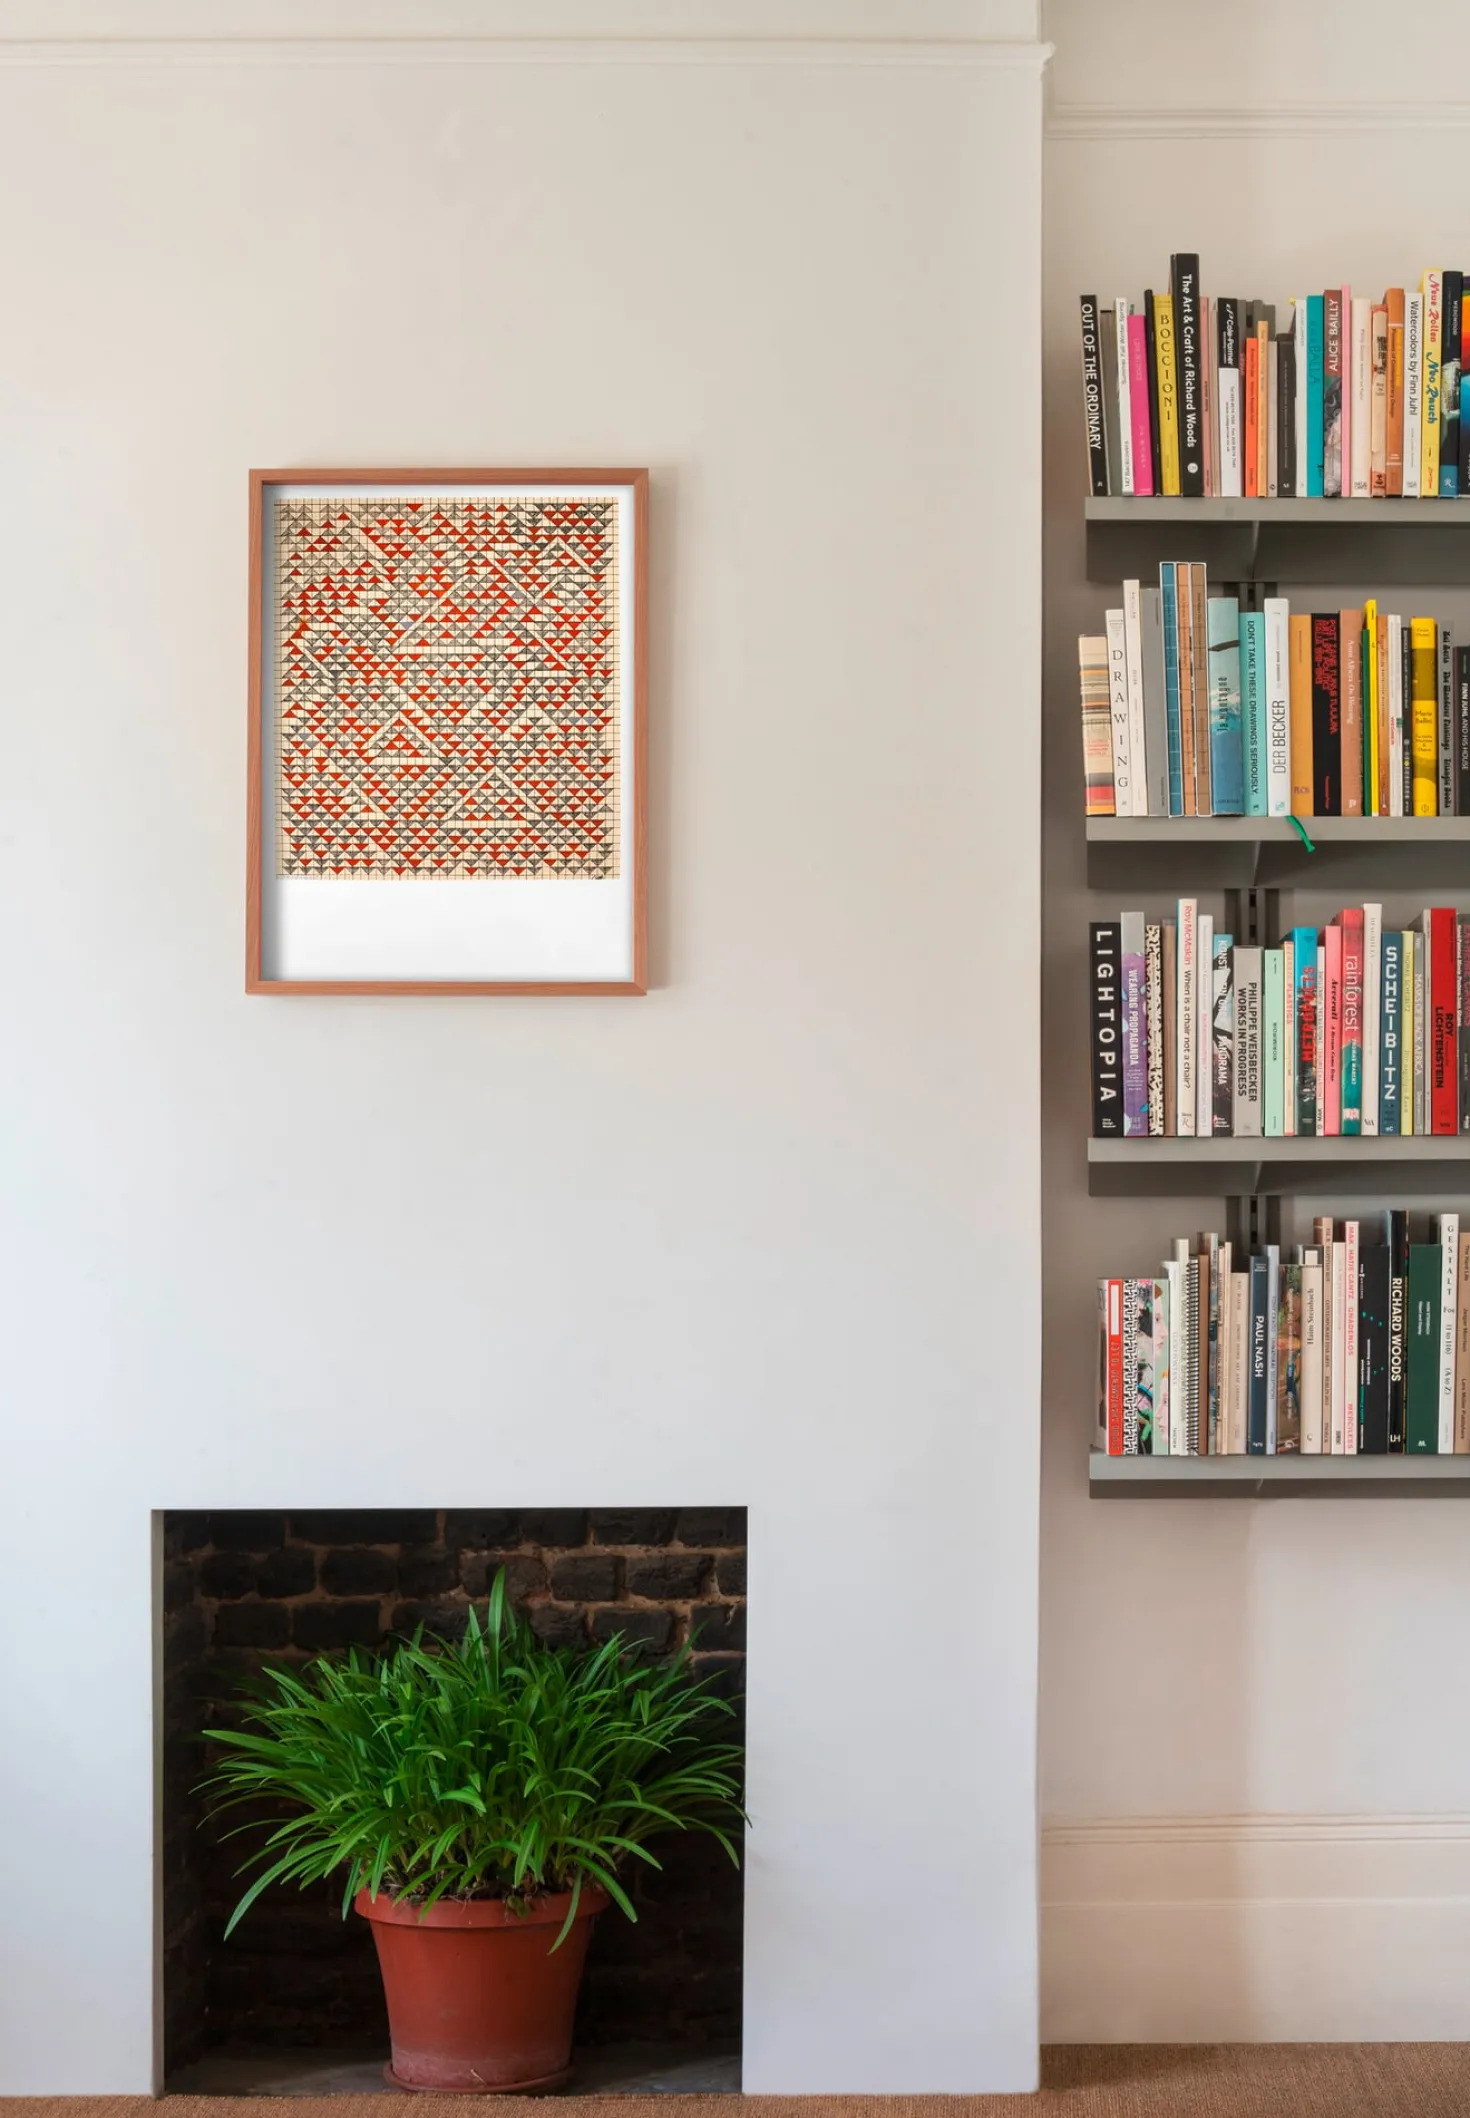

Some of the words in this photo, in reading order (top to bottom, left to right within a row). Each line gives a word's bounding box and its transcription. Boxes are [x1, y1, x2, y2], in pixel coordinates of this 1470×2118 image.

[1182, 274, 1193, 294] The
[1082, 303, 1094, 331] OUT
[1183, 296, 1193, 313] Art
[1328, 299, 1339, 336] BAILLY
[1183, 315, 1193, 324] &
[1409, 300, 1420, 359] Watercolors
[1083, 334, 1095, 353] OF
[1183, 326, 1195, 354] Craft
[1084, 356, 1097, 380] THE
[1160, 314, 1174, 421] BOCCIONI
[1184, 356, 1195, 368] of
[1328, 340, 1339, 372] ALICE
[1408, 360, 1417, 372] by
[1185, 370, 1197, 410] Richard
[1409, 374, 1418, 395] Finn
[1086, 384, 1102, 450] ORDINARY
[1409, 397, 1418, 416] Juhl
[1426, 384, 1440, 425] Rauch
[1186, 412, 1198, 448] Woods
[1247, 620, 1256, 645] DON'T
[1247, 647, 1256, 670] TAKE
[1345, 659, 1355, 683] Albers
[1248, 671, 1257, 699] THESE
[1461, 682, 1469, 700] FINN
[1111, 649, 1129, 788] DRAWING
[1249, 700, 1258, 746] DRAWINGS
[1461, 700, 1469, 718] JUHL
[1272, 700, 1287, 747] BECKER
[1461, 718, 1469, 734] AND
[1461, 734, 1469, 746] HIS
[1272, 750, 1287, 774] DER
[1461, 747, 1469, 771] HOUSE
[1182, 905, 1193, 923] Roy
[1183, 924, 1193, 966] McMakin
[1128, 969, 1139, 1009] WEARING
[1183, 970, 1193, 996] When
[1343, 955, 1362, 1032] rainforest
[1183, 996, 1193, 1005] is
[1237, 987, 1247, 1026] WORKS
[1248, 981, 1258, 1031] PHILIPPE
[1096, 930, 1117, 1102] LIGHTOPIA
[1183, 1013, 1192, 1036] chair
[1383, 946, 1398, 1101] SCHEIBITZ
[1445, 1012, 1454, 1037] ROY
[1128, 1011, 1140, 1066] PROPAGANDA
[1183, 1037, 1192, 1053] not
[1237, 1028, 1247, 1040] IN
[1434, 1005, 1444, 1089] LICHTENSTEIN
[1183, 1061, 1193, 1089] chair?
[1237, 1041, 1247, 1097] PROGRESS
[1248, 1033, 1258, 1102] WEISBECKER
[1446, 1224, 1455, 1296] GESTALT
[1347, 1272, 1355, 1300] CANTZ
[1306, 1288, 1315, 1324] Steinbach
[1391, 1276, 1403, 1331] RICHARD
[1254, 1315, 1265, 1344] PAUL
[1347, 1306, 1355, 1356] GNADENLOS
[1254, 1346, 1264, 1378] NASH
[1391, 1333, 1402, 1382] WOODS
[1346, 1403, 1355, 1449] MERCILESS
